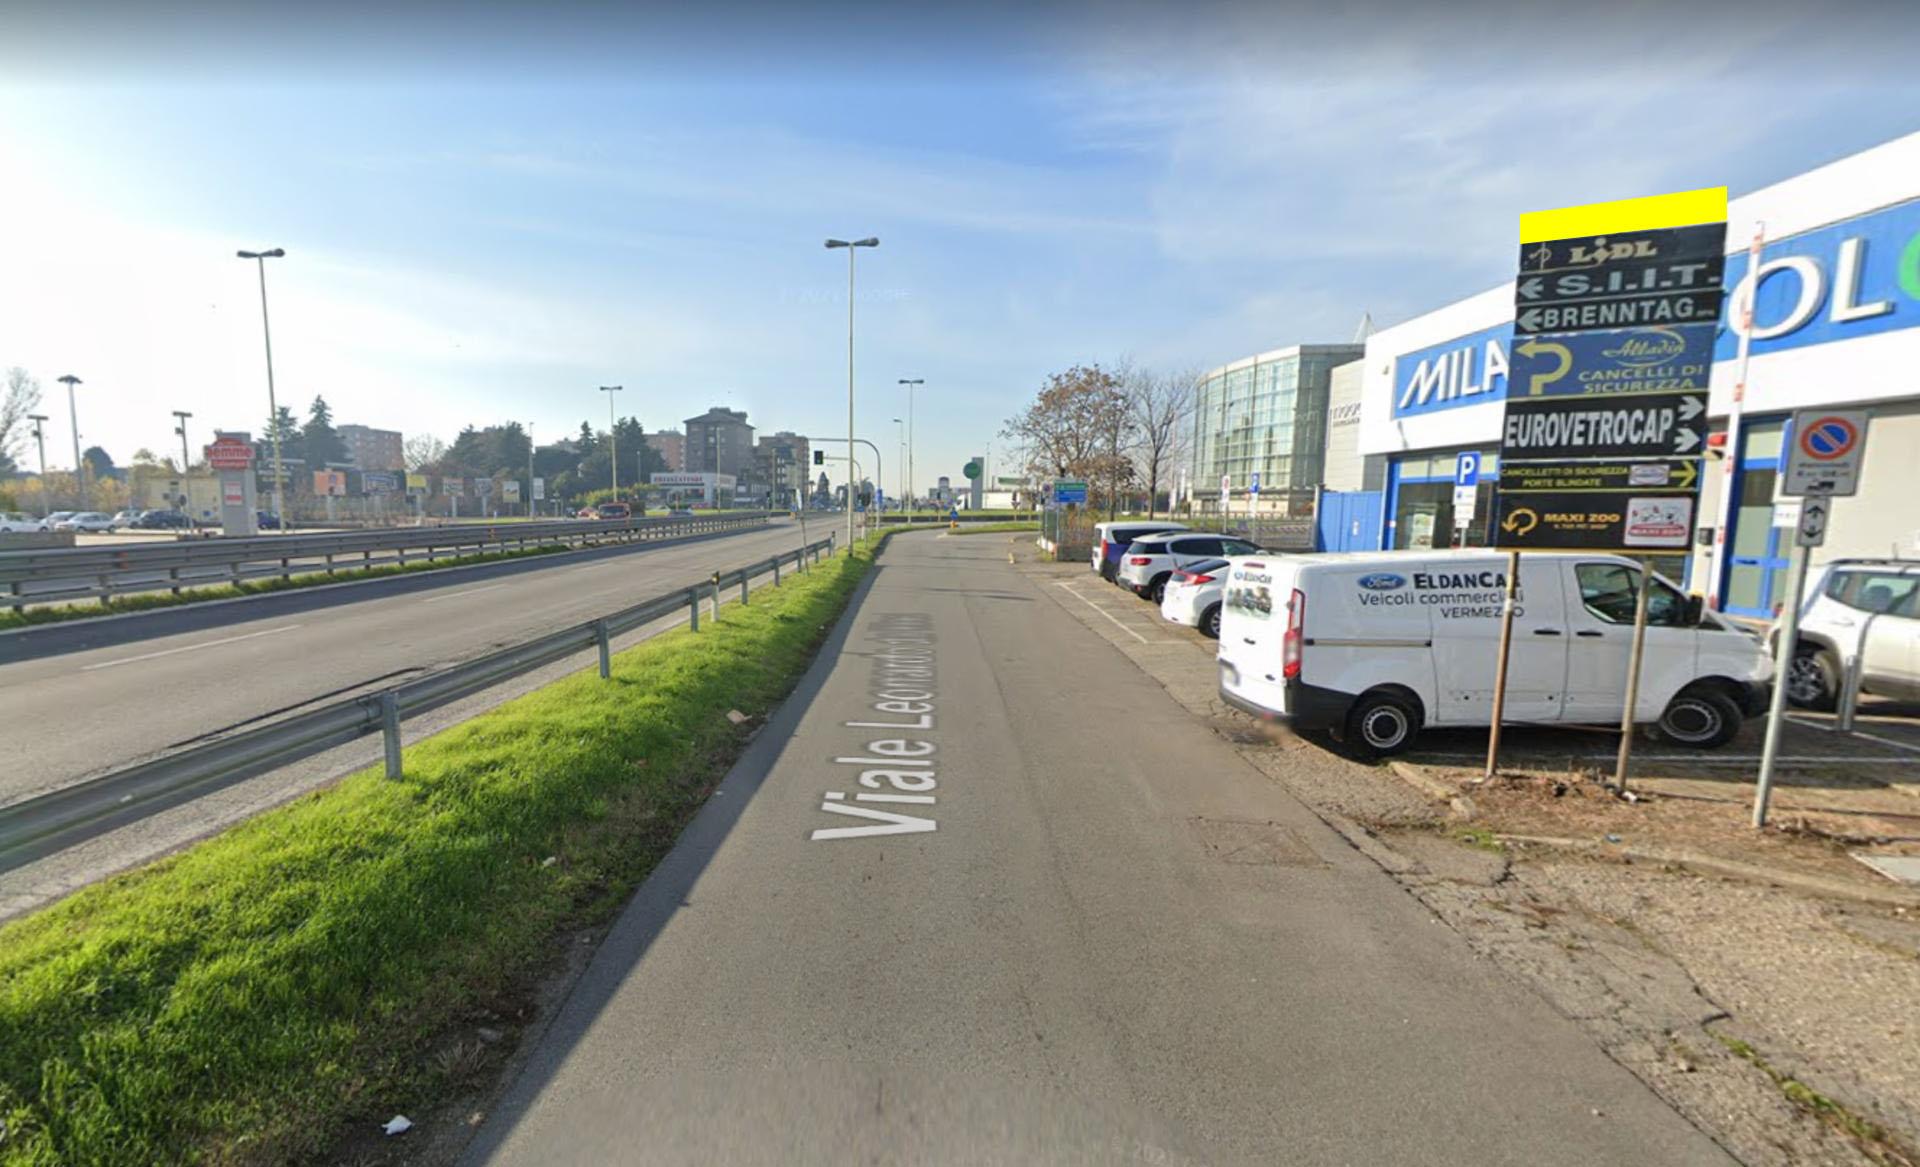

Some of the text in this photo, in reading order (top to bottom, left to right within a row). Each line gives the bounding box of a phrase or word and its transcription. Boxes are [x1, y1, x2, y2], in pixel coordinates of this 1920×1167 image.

[1543, 297, 1694, 329] BRENNTAG
[1578, 364, 1704, 382] CANCELLI DI
[1583, 377, 1695, 393] SICUREZZA
[1504, 408, 1673, 448] EUROVETROCAP
[1459, 455, 1476, 484] P
[1544, 513, 1620, 523] MAXI ZOO
[1358, 592, 1414, 606] Veicoli
[1440, 606, 1525, 618] VERMEZO
